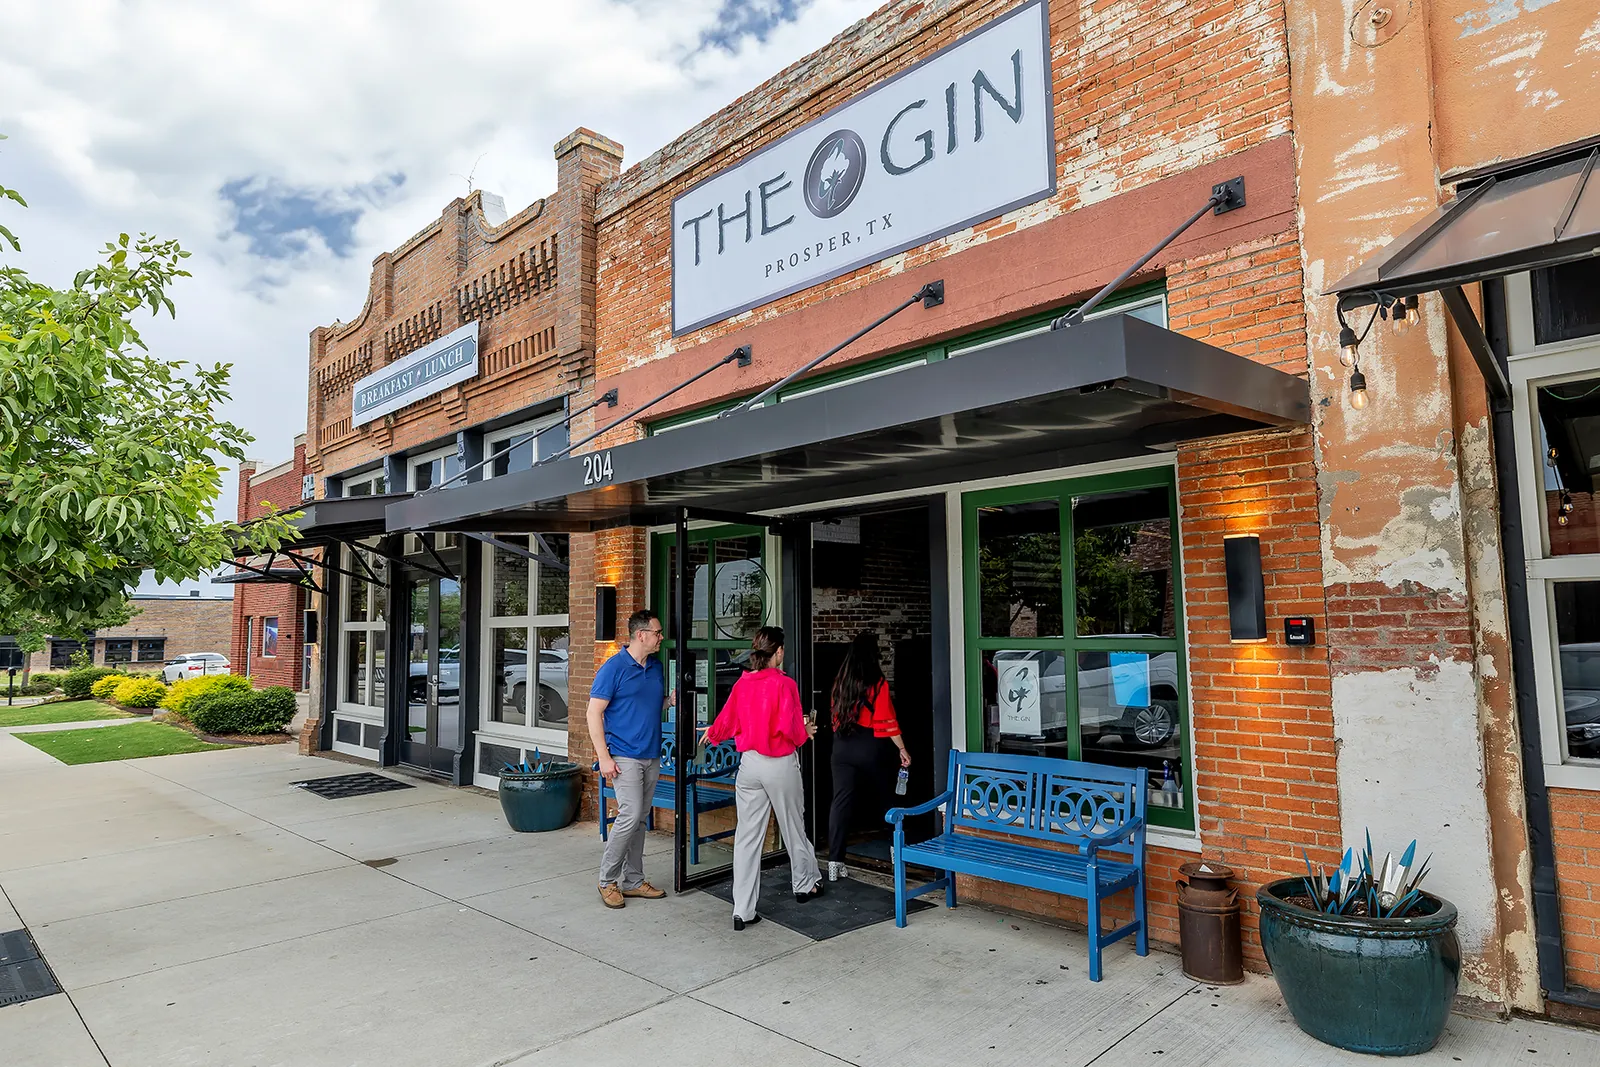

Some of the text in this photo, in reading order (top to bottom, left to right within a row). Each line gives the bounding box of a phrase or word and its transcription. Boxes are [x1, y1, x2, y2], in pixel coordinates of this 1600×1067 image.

[682, 48, 1023, 266] THE GIN
[866, 213, 892, 236] TX
[361, 346, 464, 408] BREAKFAST LUNCH
[583, 451, 613, 485] 204
